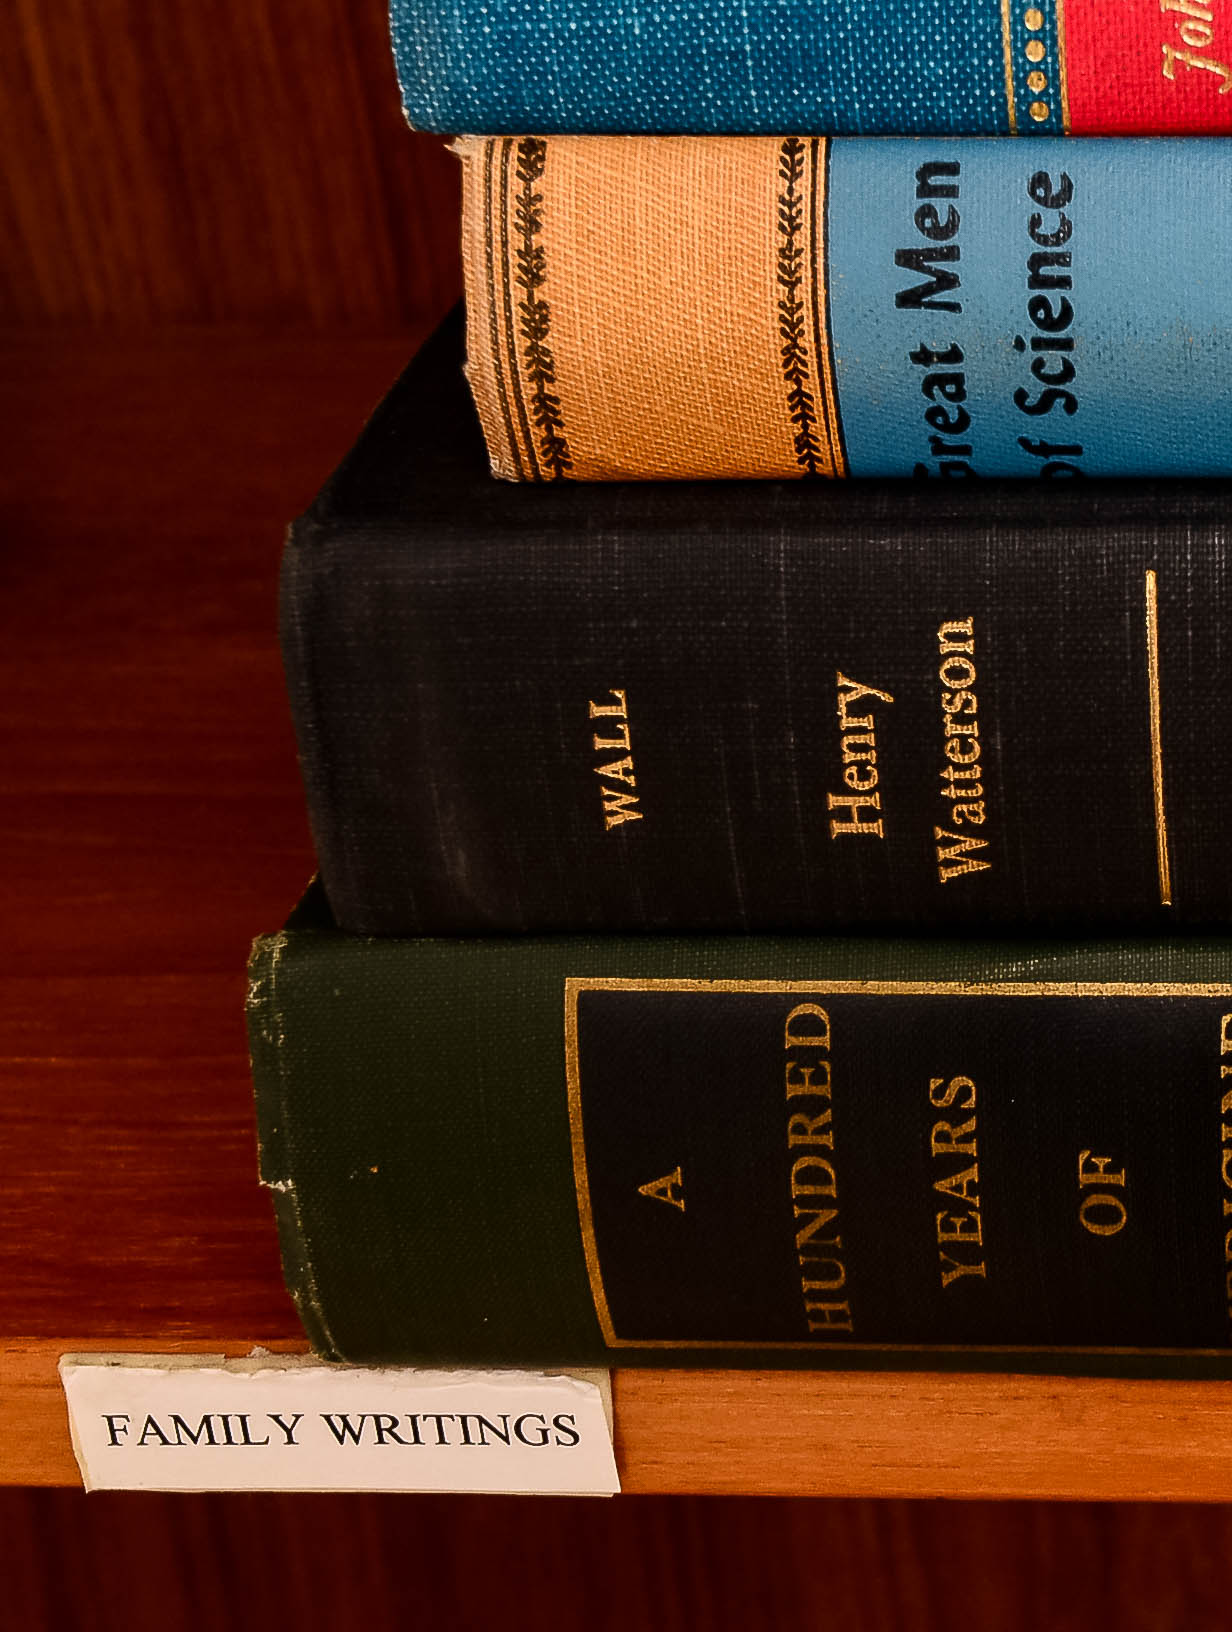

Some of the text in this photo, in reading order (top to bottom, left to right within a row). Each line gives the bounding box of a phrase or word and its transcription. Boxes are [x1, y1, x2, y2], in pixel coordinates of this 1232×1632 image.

[894, 160, 963, 315] Men
[1012, 169, 1079, 416] Science
[589, 688, 645, 831] WALL
[826, 671, 895, 840] Henry
[933, 616, 992, 884] Watterson
[636, 1165, 686, 1213] A
[784, 1002, 855, 1334] HUNDRED
[928, 1074, 988, 1289] YEARS
[1077, 1148, 1128, 1237] OF
[101, 1412, 582, 1448] FAMILY WRITINGS
